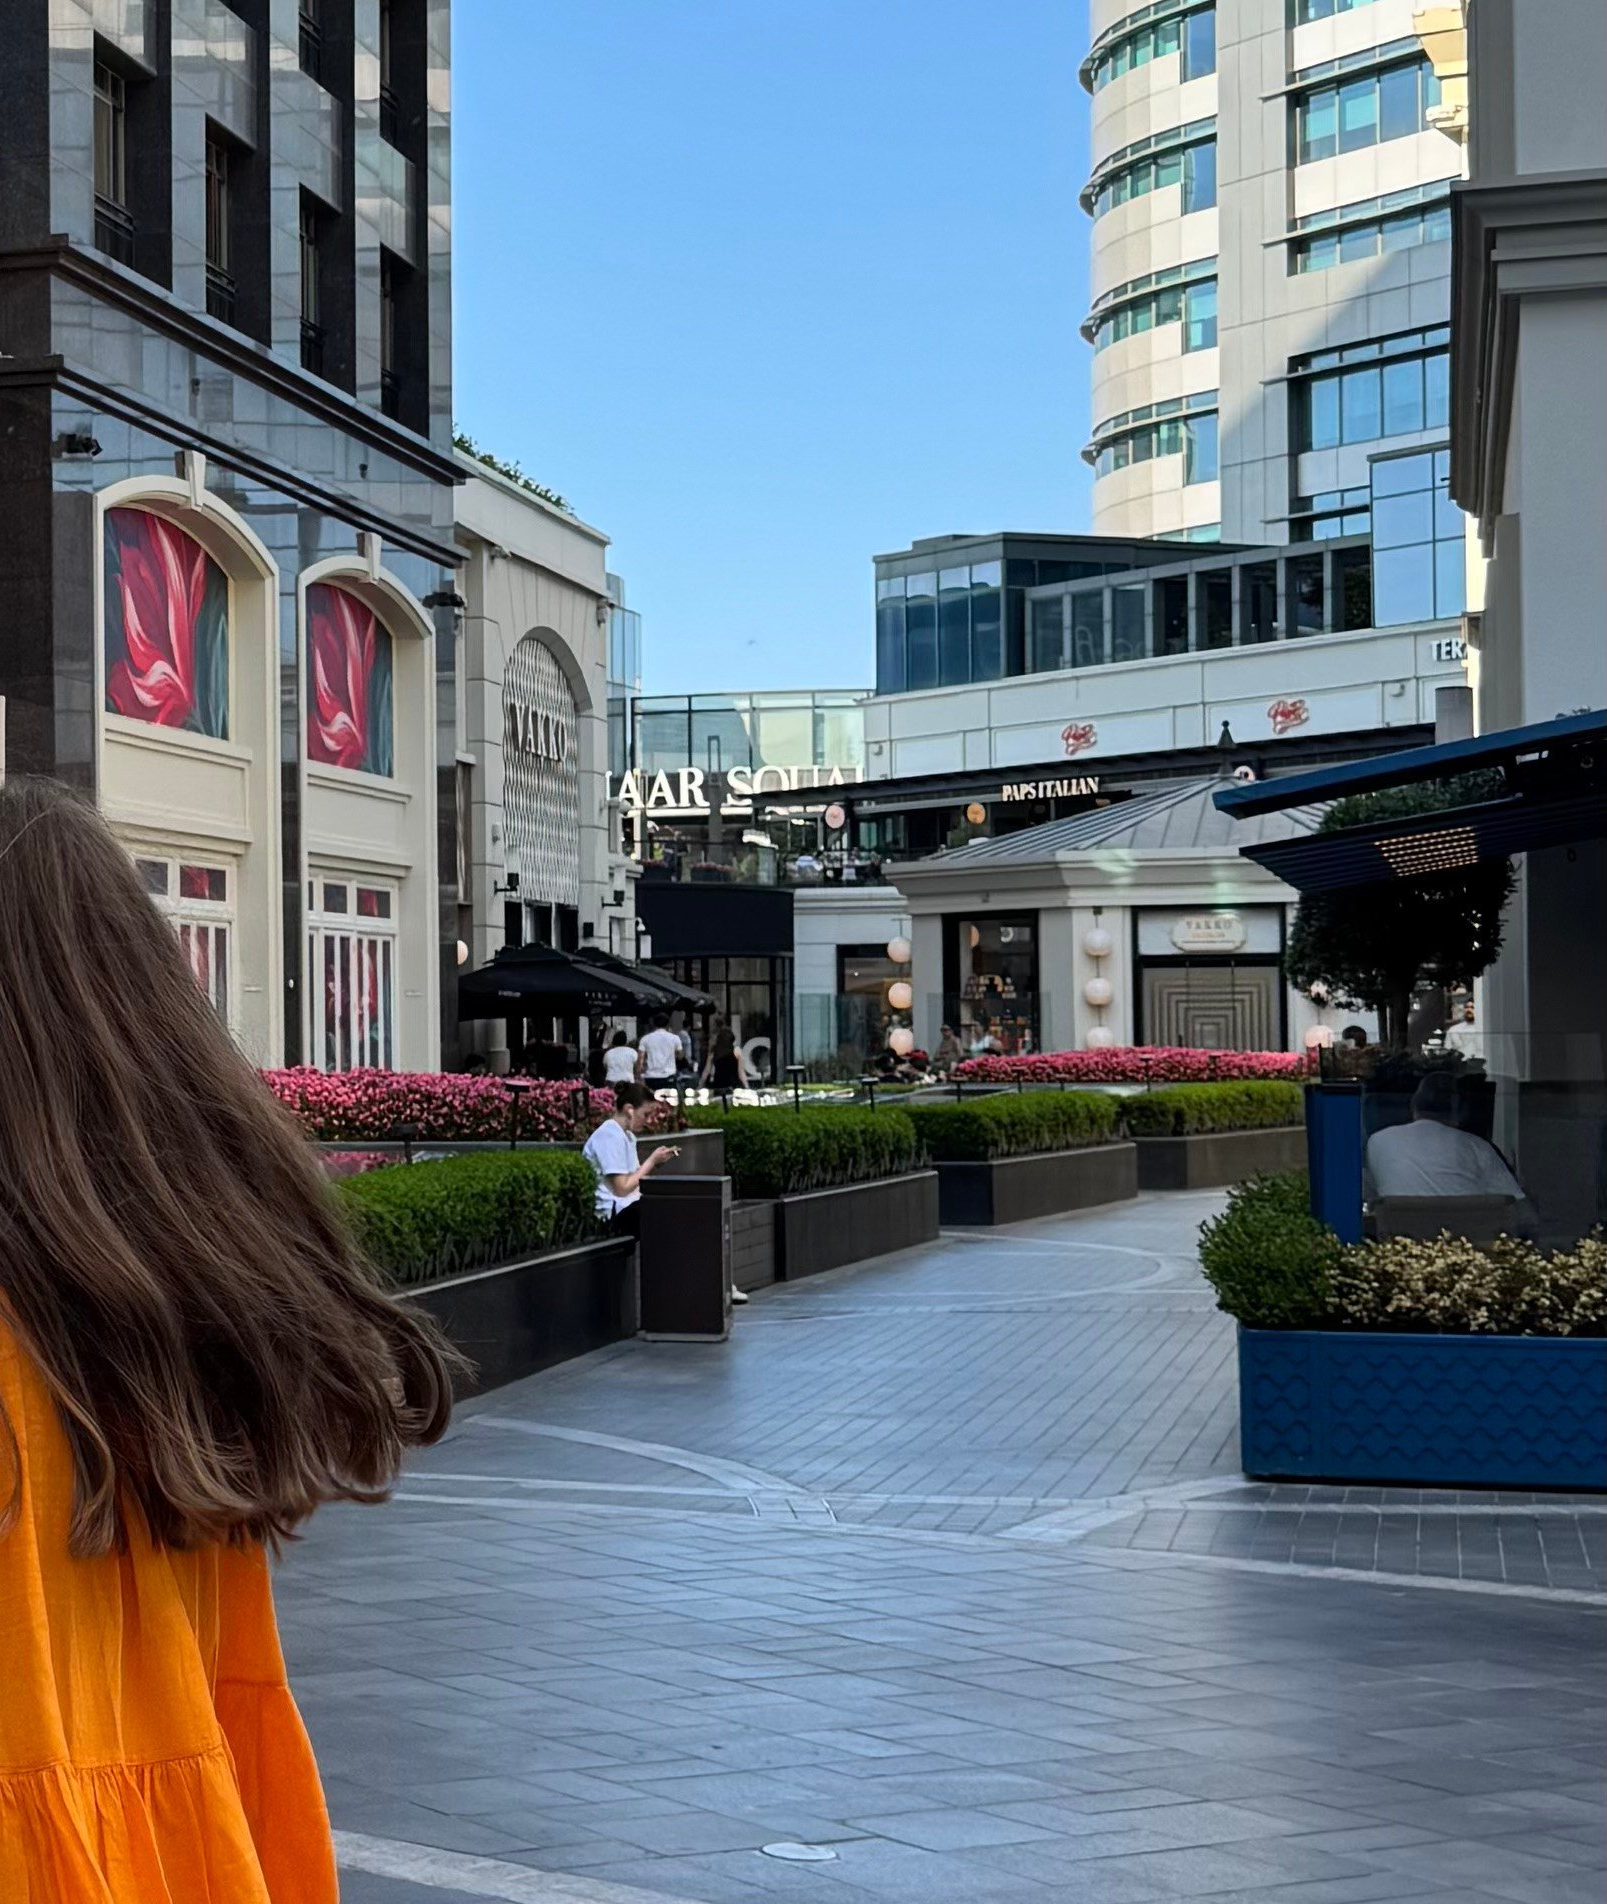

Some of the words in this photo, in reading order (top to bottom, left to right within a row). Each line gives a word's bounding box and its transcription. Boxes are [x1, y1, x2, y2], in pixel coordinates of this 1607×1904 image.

[509, 702, 568, 763] VAKKO
[605, 766, 711, 808] AAR
[1001, 782, 1036, 802] PAPS
[1038, 776, 1099, 799] ITALIAN
[1185, 919, 1233, 931] VAKKO
